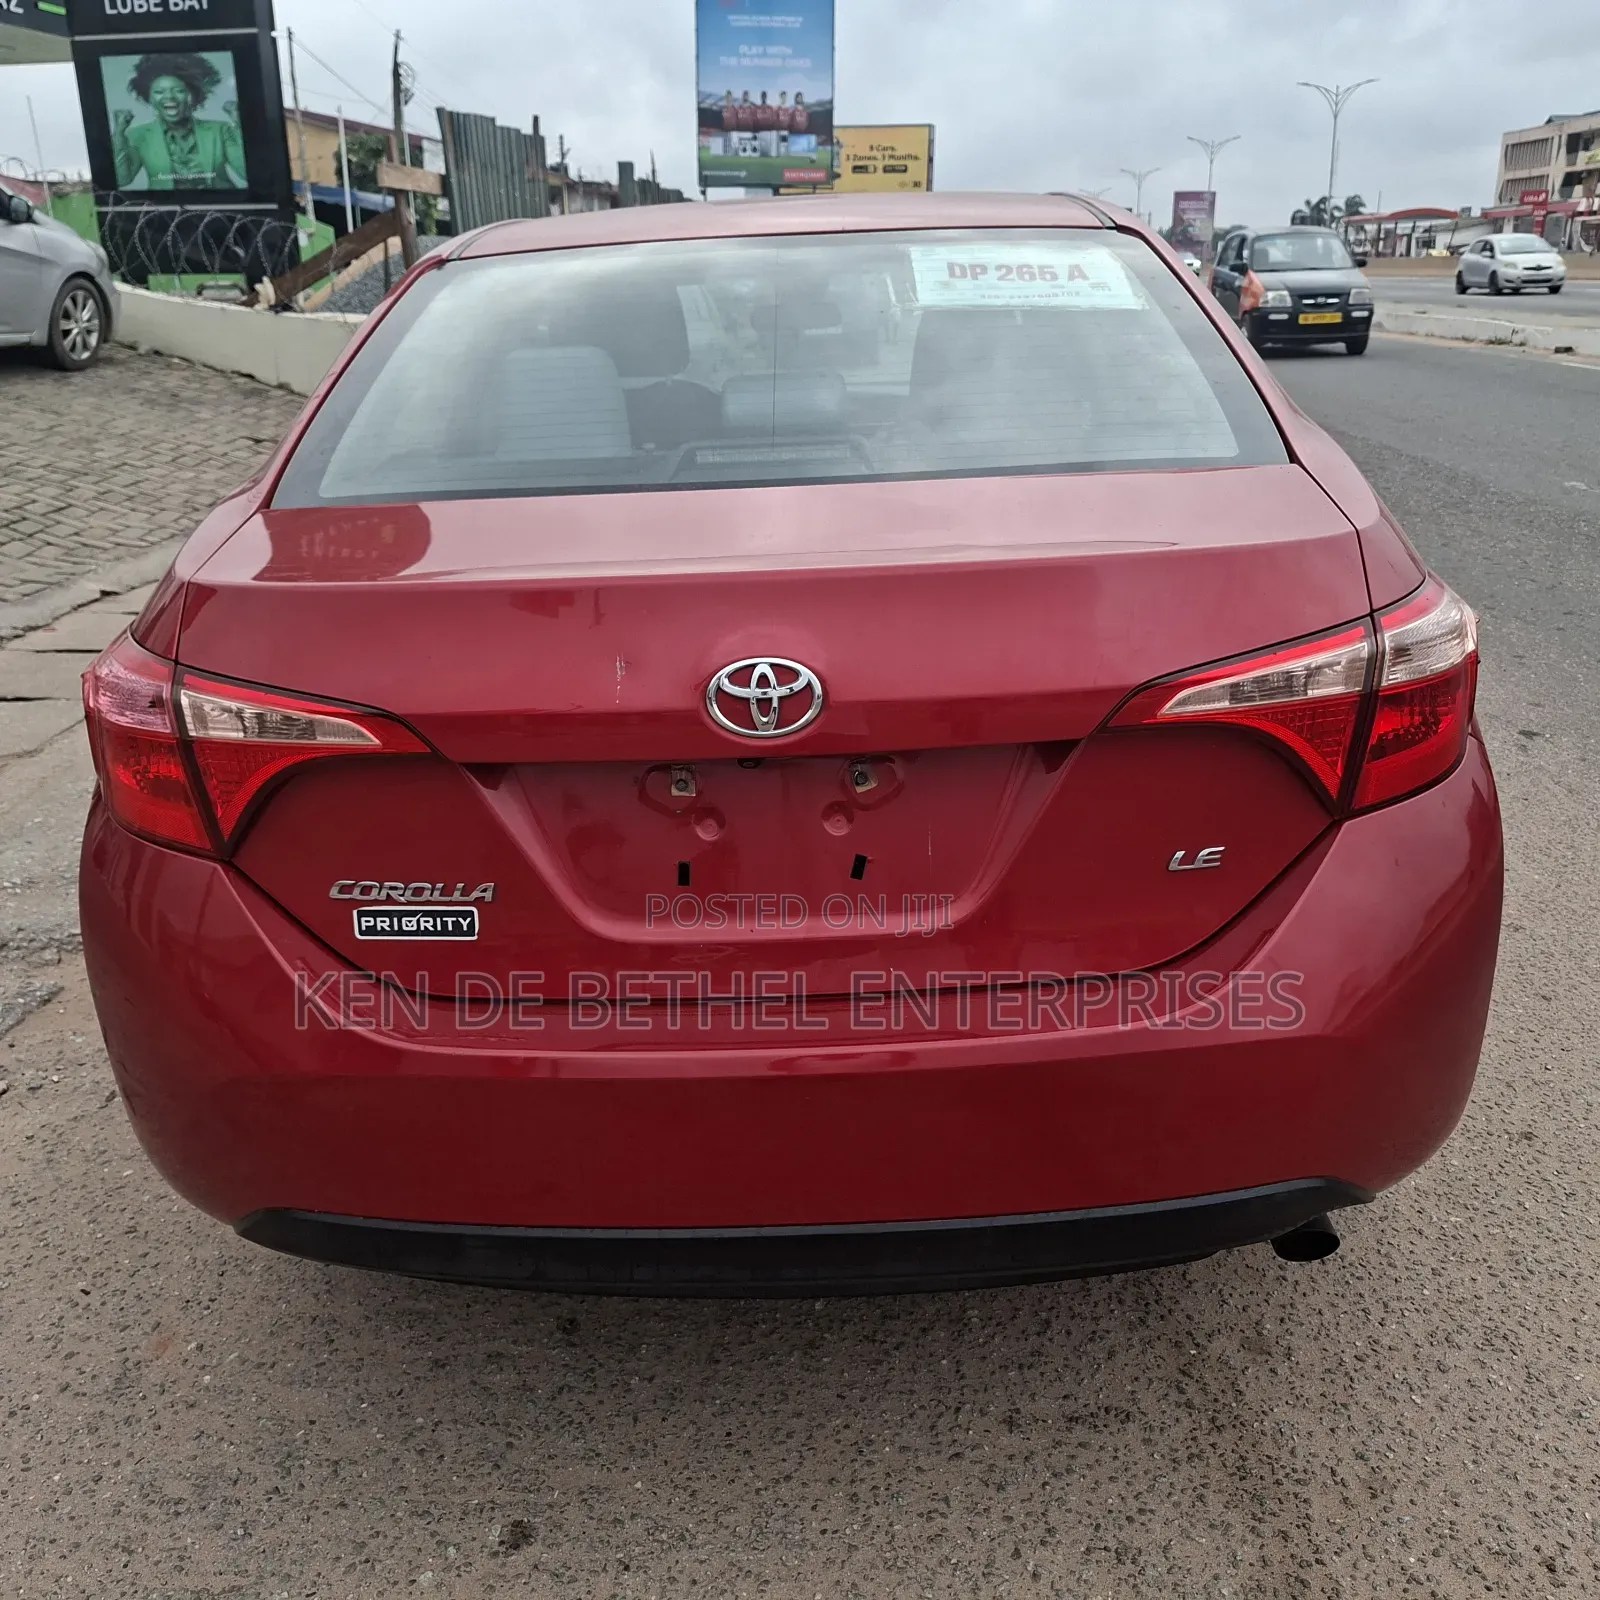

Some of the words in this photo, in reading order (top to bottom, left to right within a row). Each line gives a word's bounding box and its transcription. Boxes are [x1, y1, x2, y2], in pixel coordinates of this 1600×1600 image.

[104, 0, 163, 15] LUBE
[946, 262, 988, 281] DP
[993, 264, 1059, 282] 265
[1066, 264, 1091, 282] A
[1167, 846, 1226, 871] LE
[329, 879, 495, 903] COROLLA
[360, 912, 473, 932] PRIORITY
